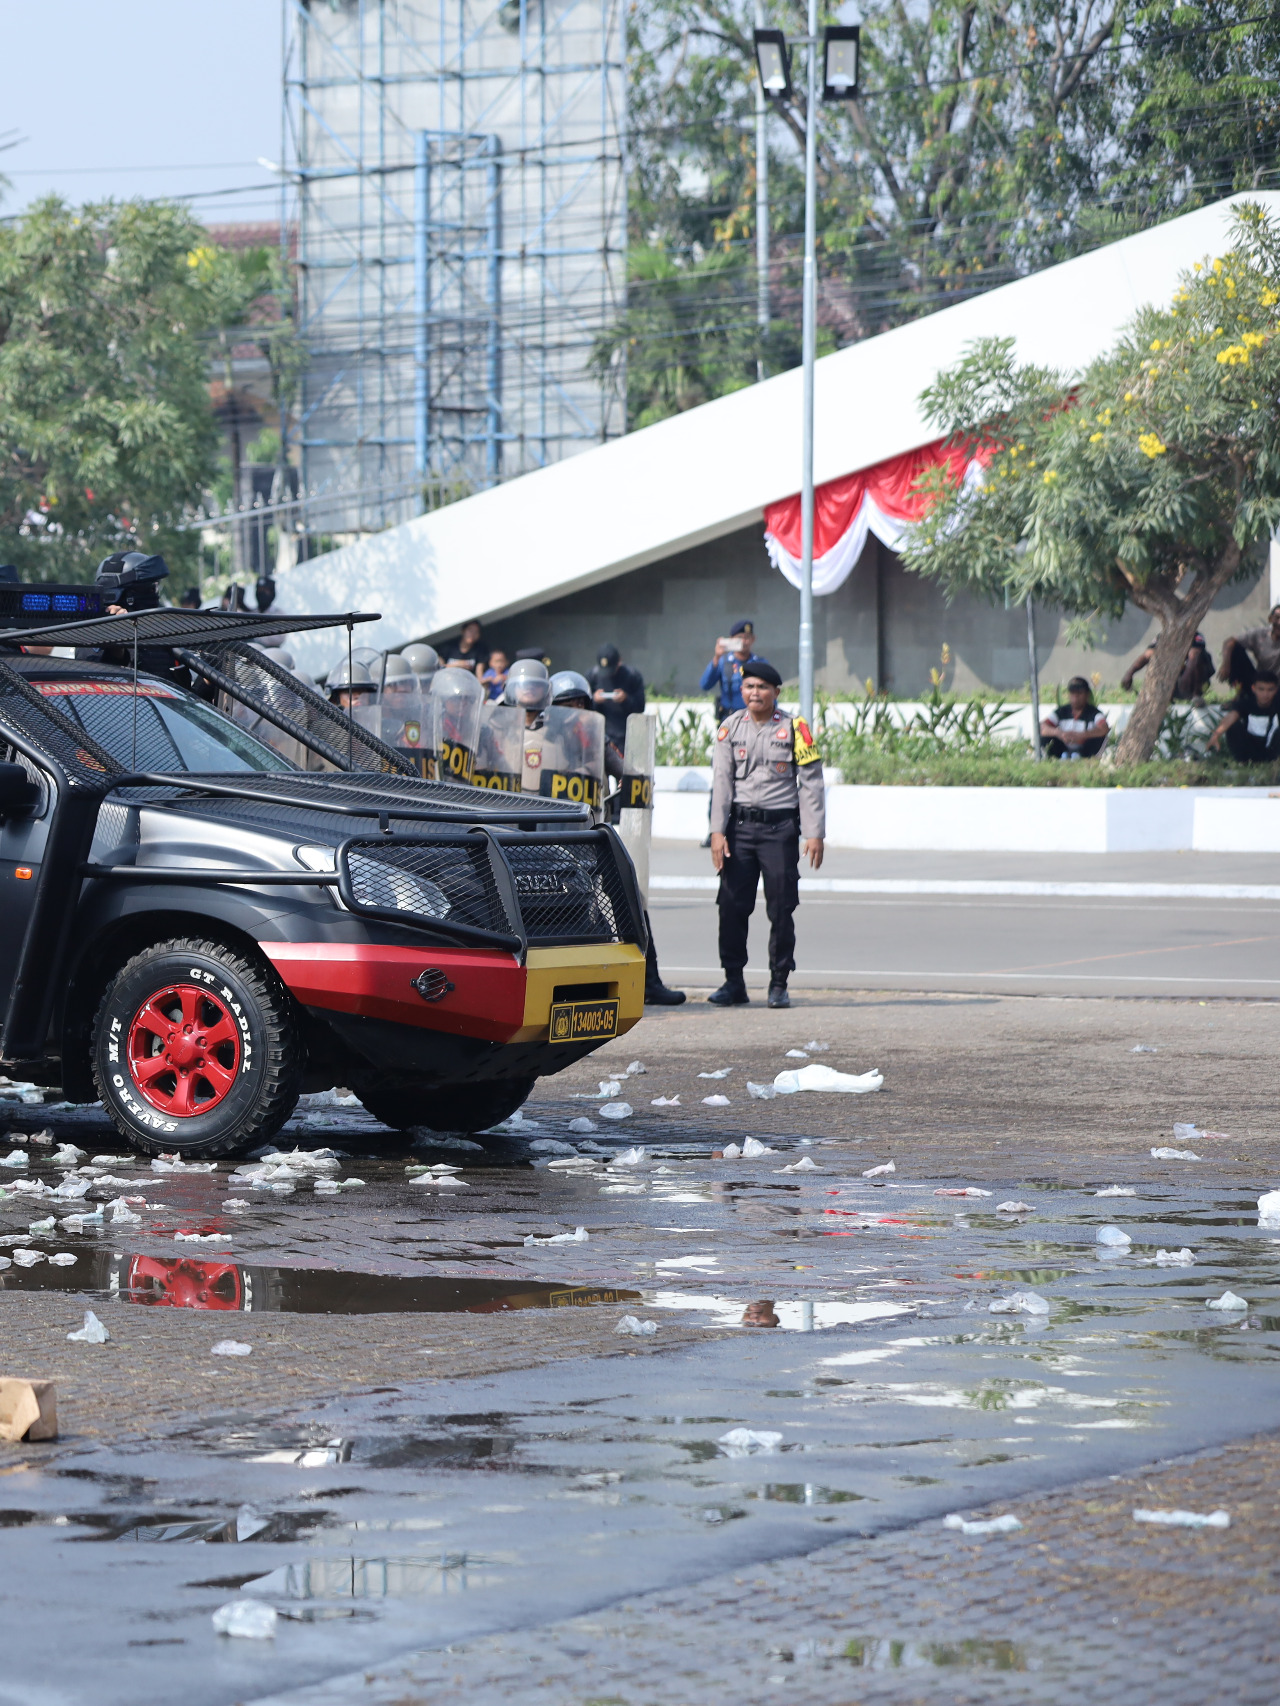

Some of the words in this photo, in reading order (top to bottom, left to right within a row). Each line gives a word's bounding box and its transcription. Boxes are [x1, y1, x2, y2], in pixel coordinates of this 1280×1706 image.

[108, 1017, 122, 1063] M/T
[189, 968, 216, 985] GT
[220, 986, 253, 1073] RADIAL
[573, 1009, 614, 1033] 134003-05
[112, 1074, 178, 1132] SAVERO
